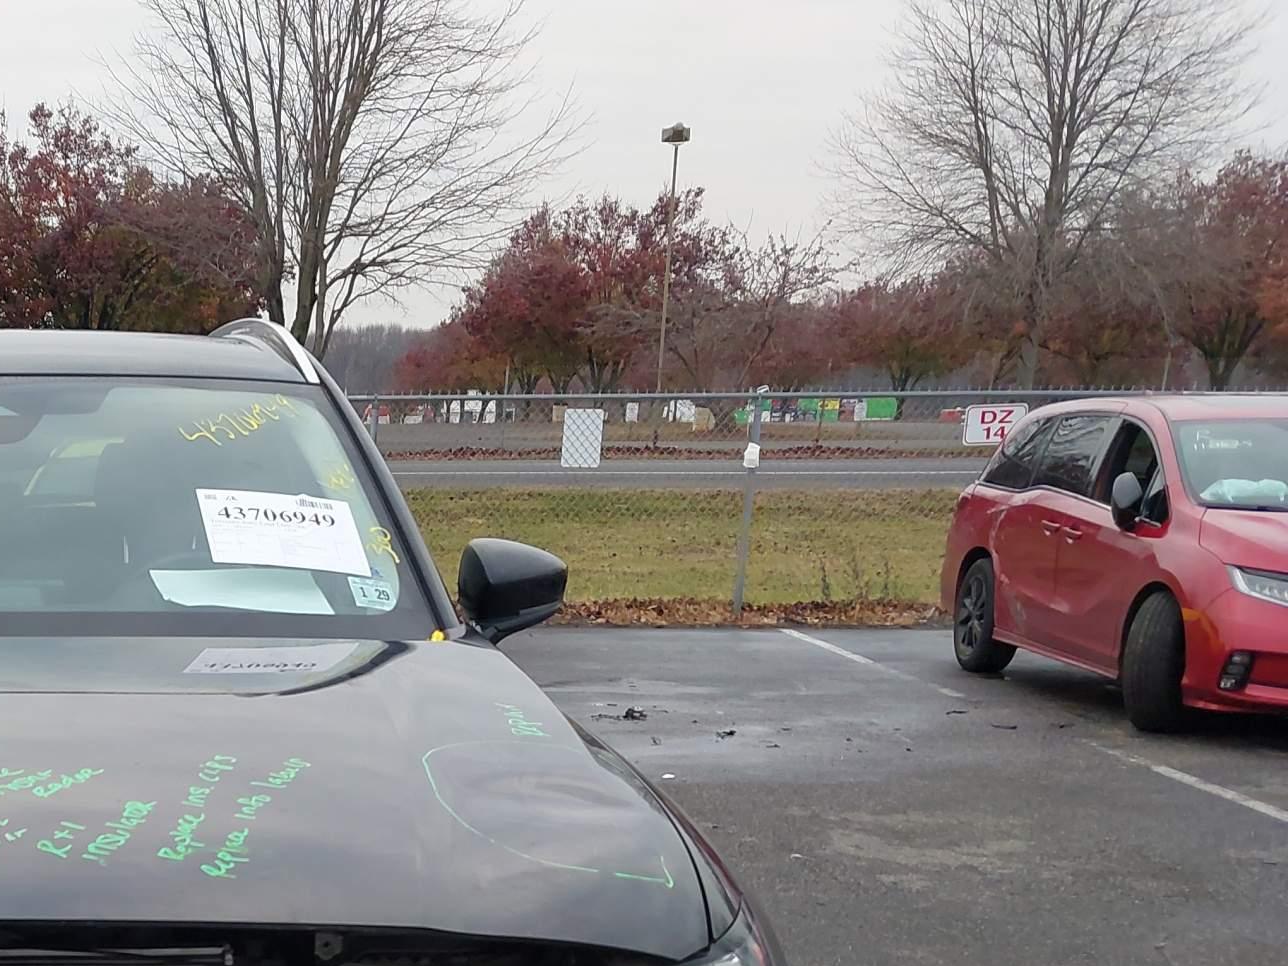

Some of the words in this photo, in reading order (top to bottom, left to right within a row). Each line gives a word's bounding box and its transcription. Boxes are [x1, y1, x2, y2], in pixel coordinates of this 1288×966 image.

[980, 409, 1015, 425] DZ
[982, 426, 1006, 440] 14
[217, 505, 336, 528] 43706949
[359, 586, 368, 598] 1
[374, 588, 390, 601] 29
